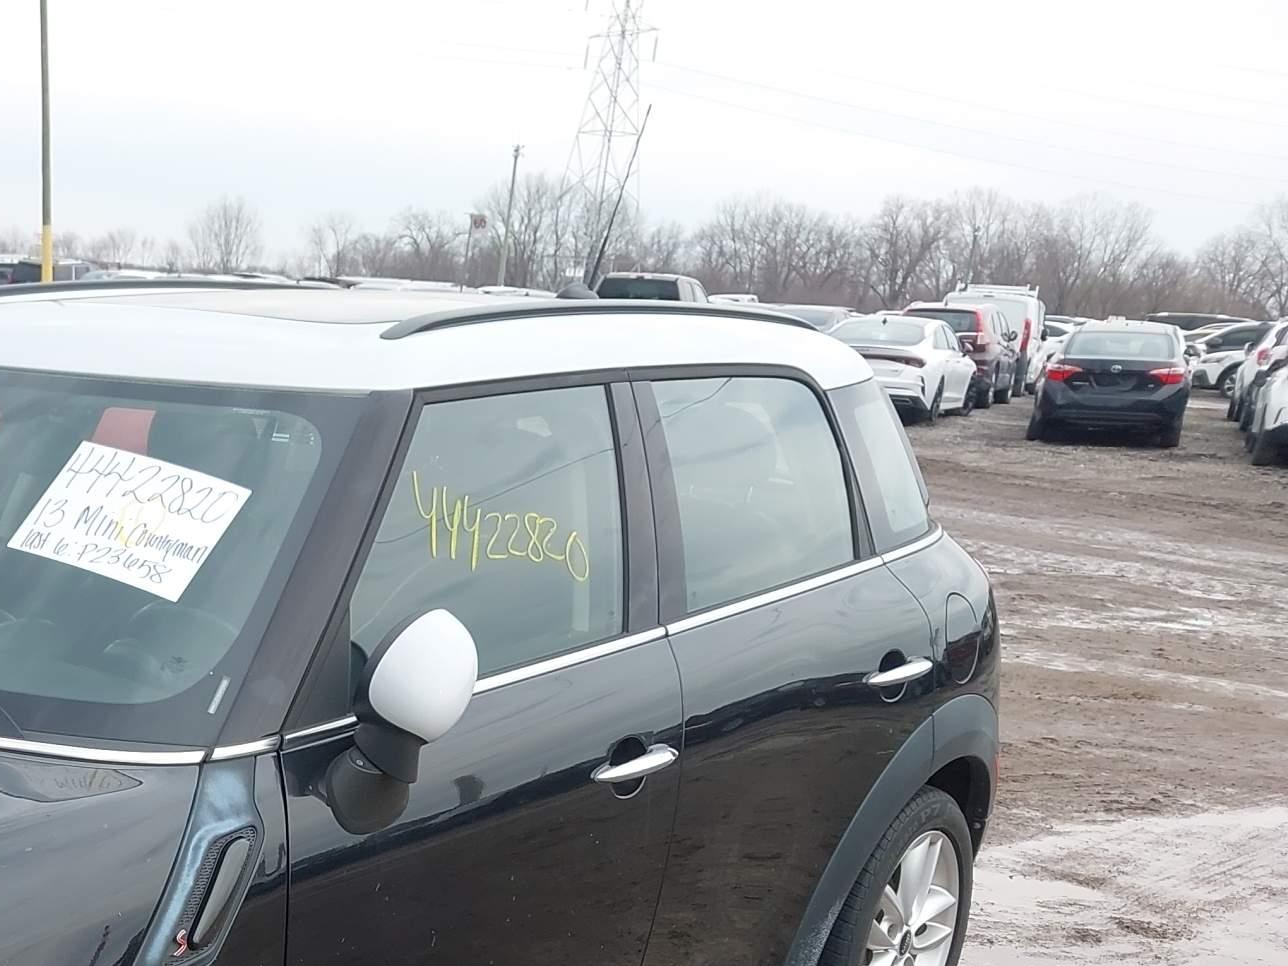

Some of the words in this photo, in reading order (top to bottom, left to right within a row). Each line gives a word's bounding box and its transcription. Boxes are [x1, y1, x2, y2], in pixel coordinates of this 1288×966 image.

[33, 498, 66, 529] 13
[65, 447, 239, 524] 44422820
[412, 470, 590, 581] 44422820
